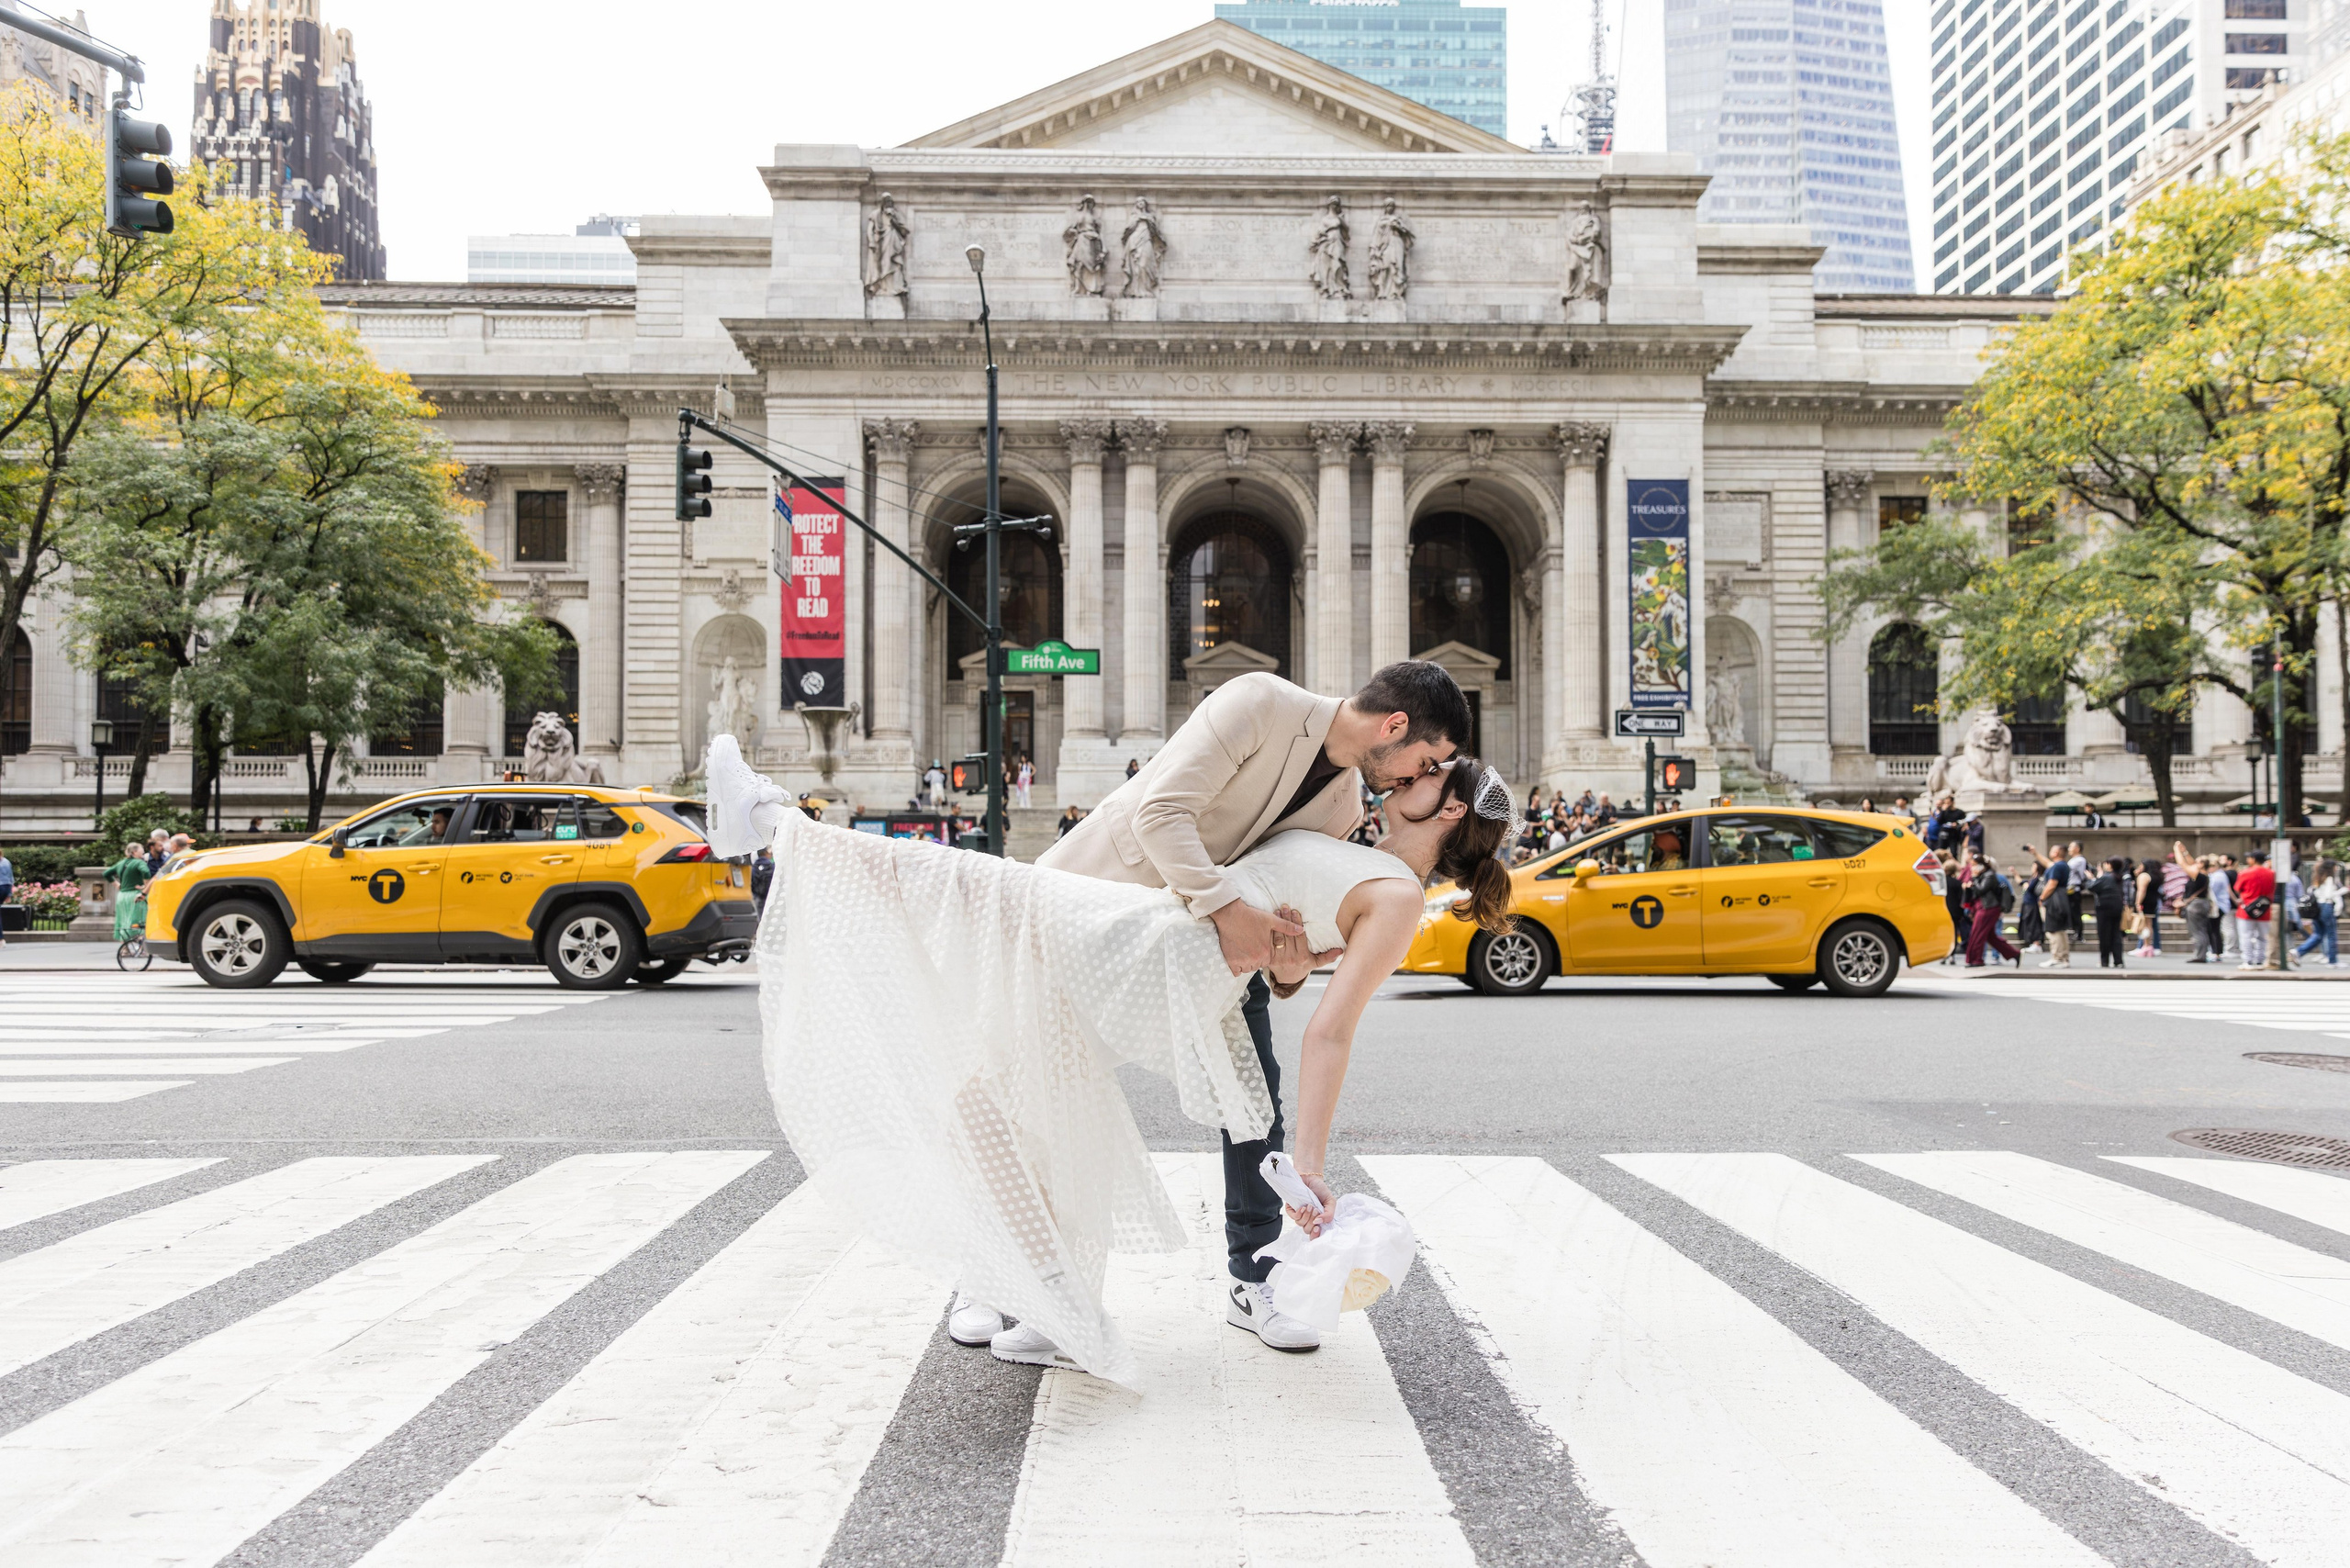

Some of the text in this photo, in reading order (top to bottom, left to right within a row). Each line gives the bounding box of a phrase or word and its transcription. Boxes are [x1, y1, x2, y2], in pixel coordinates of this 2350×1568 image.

[922, 218, 1057, 230] THE ASTOR LIBRARY
[1251, 220, 1304, 231] LIBRARY
[1416, 221, 1441, 234] THE
[1508, 222, 1549, 234] TRUST
[872, 376, 964, 388] MDCCCXCV
[1015, 374, 1461, 394] THE NEW YORK PUBLIC LIBRARY
[1630, 504, 1686, 515] TREASURES
[791, 513, 840, 534] ROTECT
[800, 534, 824, 554] THE
[791, 555, 840, 576] REEDOM
[804, 577, 821, 597] TO
[797, 598, 829, 618] READ
[1022, 655, 1085, 669] Fifth Ave
[1628, 720, 1673, 728] ONE WAY
[555, 824, 577, 834] curb
[376, 875, 397, 901] T
[1637, 901, 1657, 925] T
